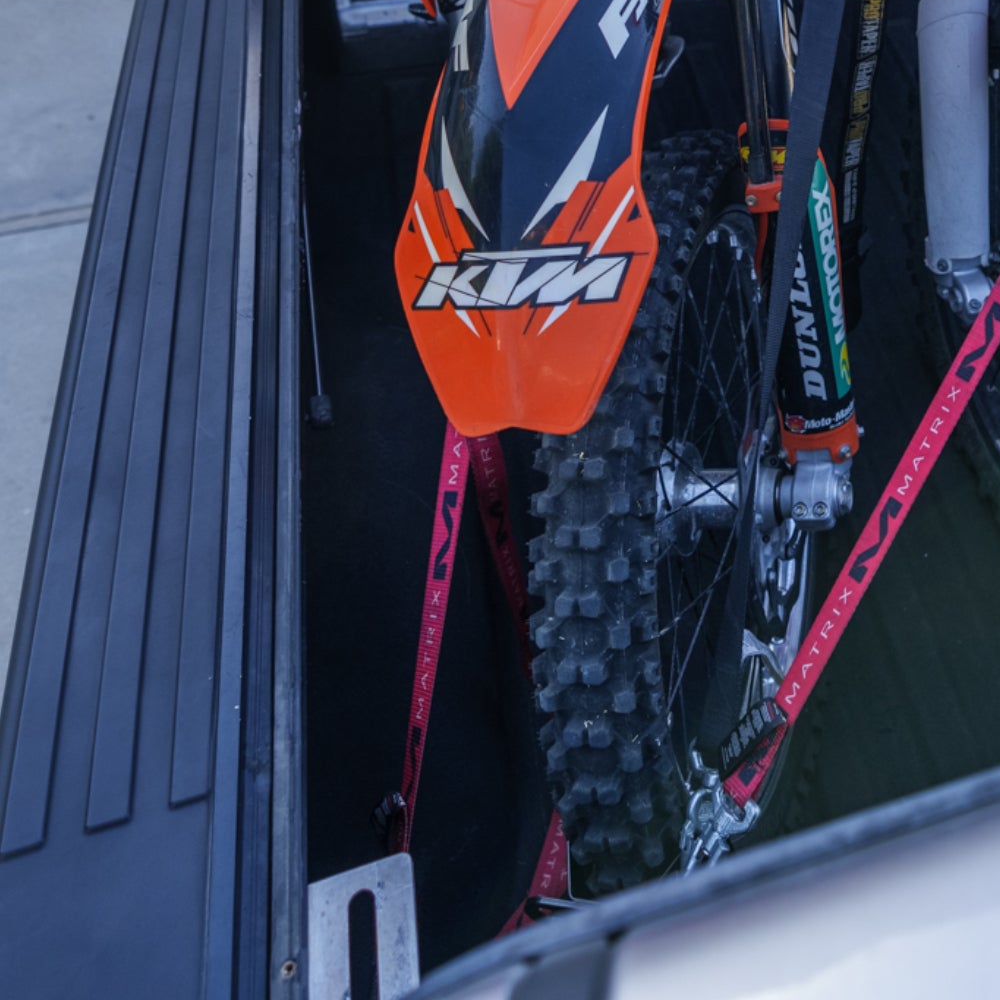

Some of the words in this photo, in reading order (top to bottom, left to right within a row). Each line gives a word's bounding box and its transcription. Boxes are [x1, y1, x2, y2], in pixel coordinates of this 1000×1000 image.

[412, 243, 636, 310] KTM
[790, 243, 827, 401] DUNLO
[812, 183, 847, 346] MOTOREX
[897, 386, 961, 495] MATRIX
[415, 590, 441, 719] MATRIX
[784, 587, 853, 704] MATRIX
